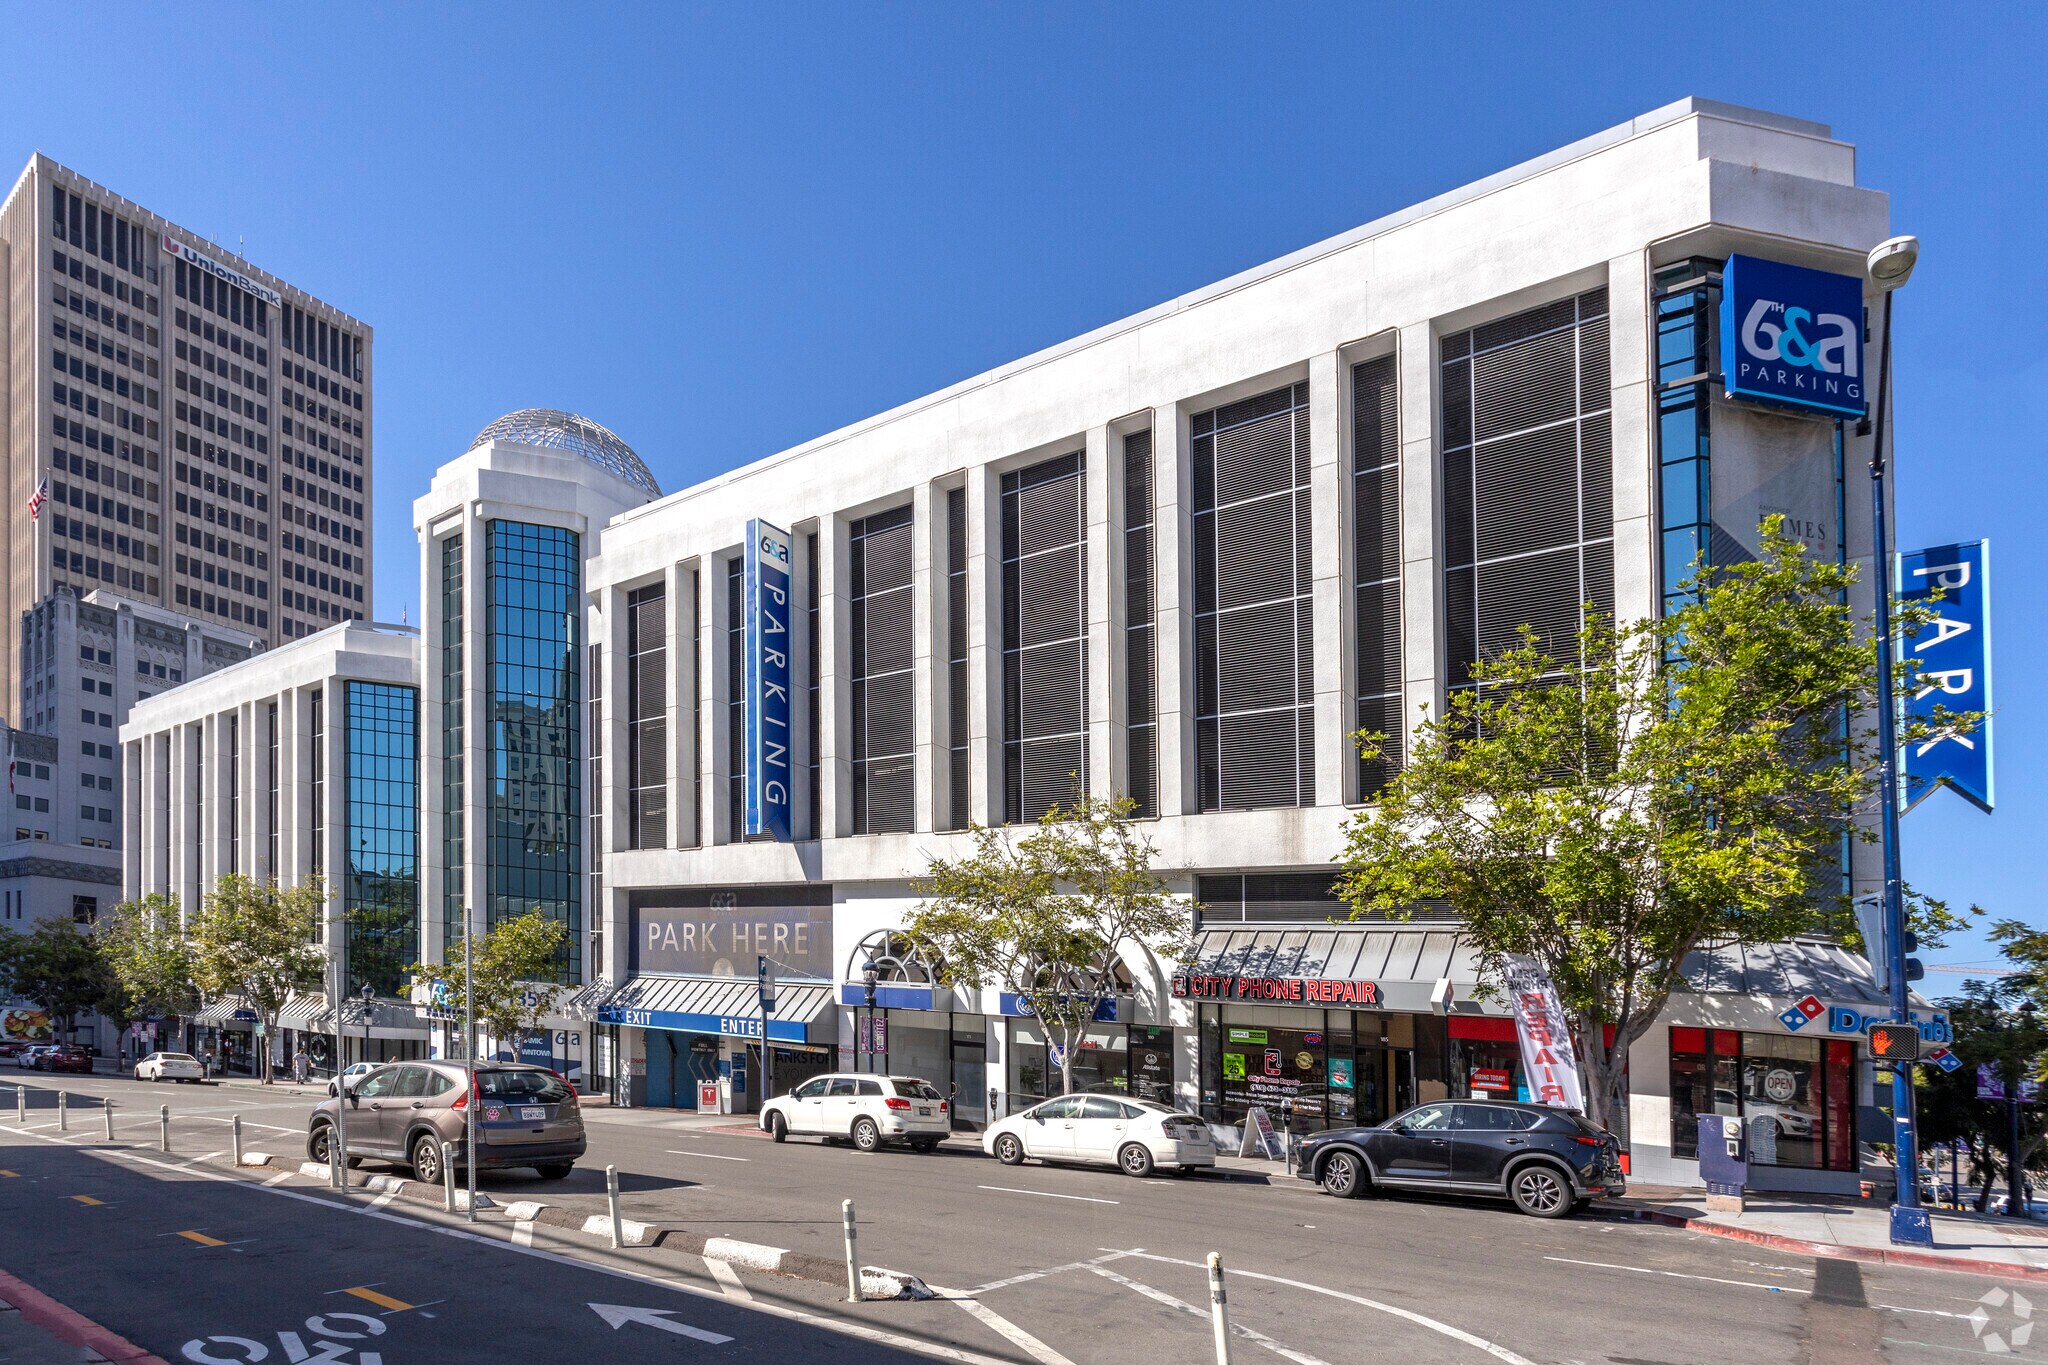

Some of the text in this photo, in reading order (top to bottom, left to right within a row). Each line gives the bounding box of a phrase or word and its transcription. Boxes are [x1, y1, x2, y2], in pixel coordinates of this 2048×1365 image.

[184, 248, 280, 306] UnionBank
[1741, 363, 1860, 399] PARKING
[1911, 561, 1976, 758] PARK
[763, 582, 787, 806] PARKING
[648, 922, 809, 956] PARK HERE
[1191, 976, 1377, 1003] CITY PHONE REPAIR
[626, 1010, 763, 1036] EXIT ENTER
[1474, 1073, 1490, 1081] HIRING
[1767, 1077, 1793, 1089] OPEN
